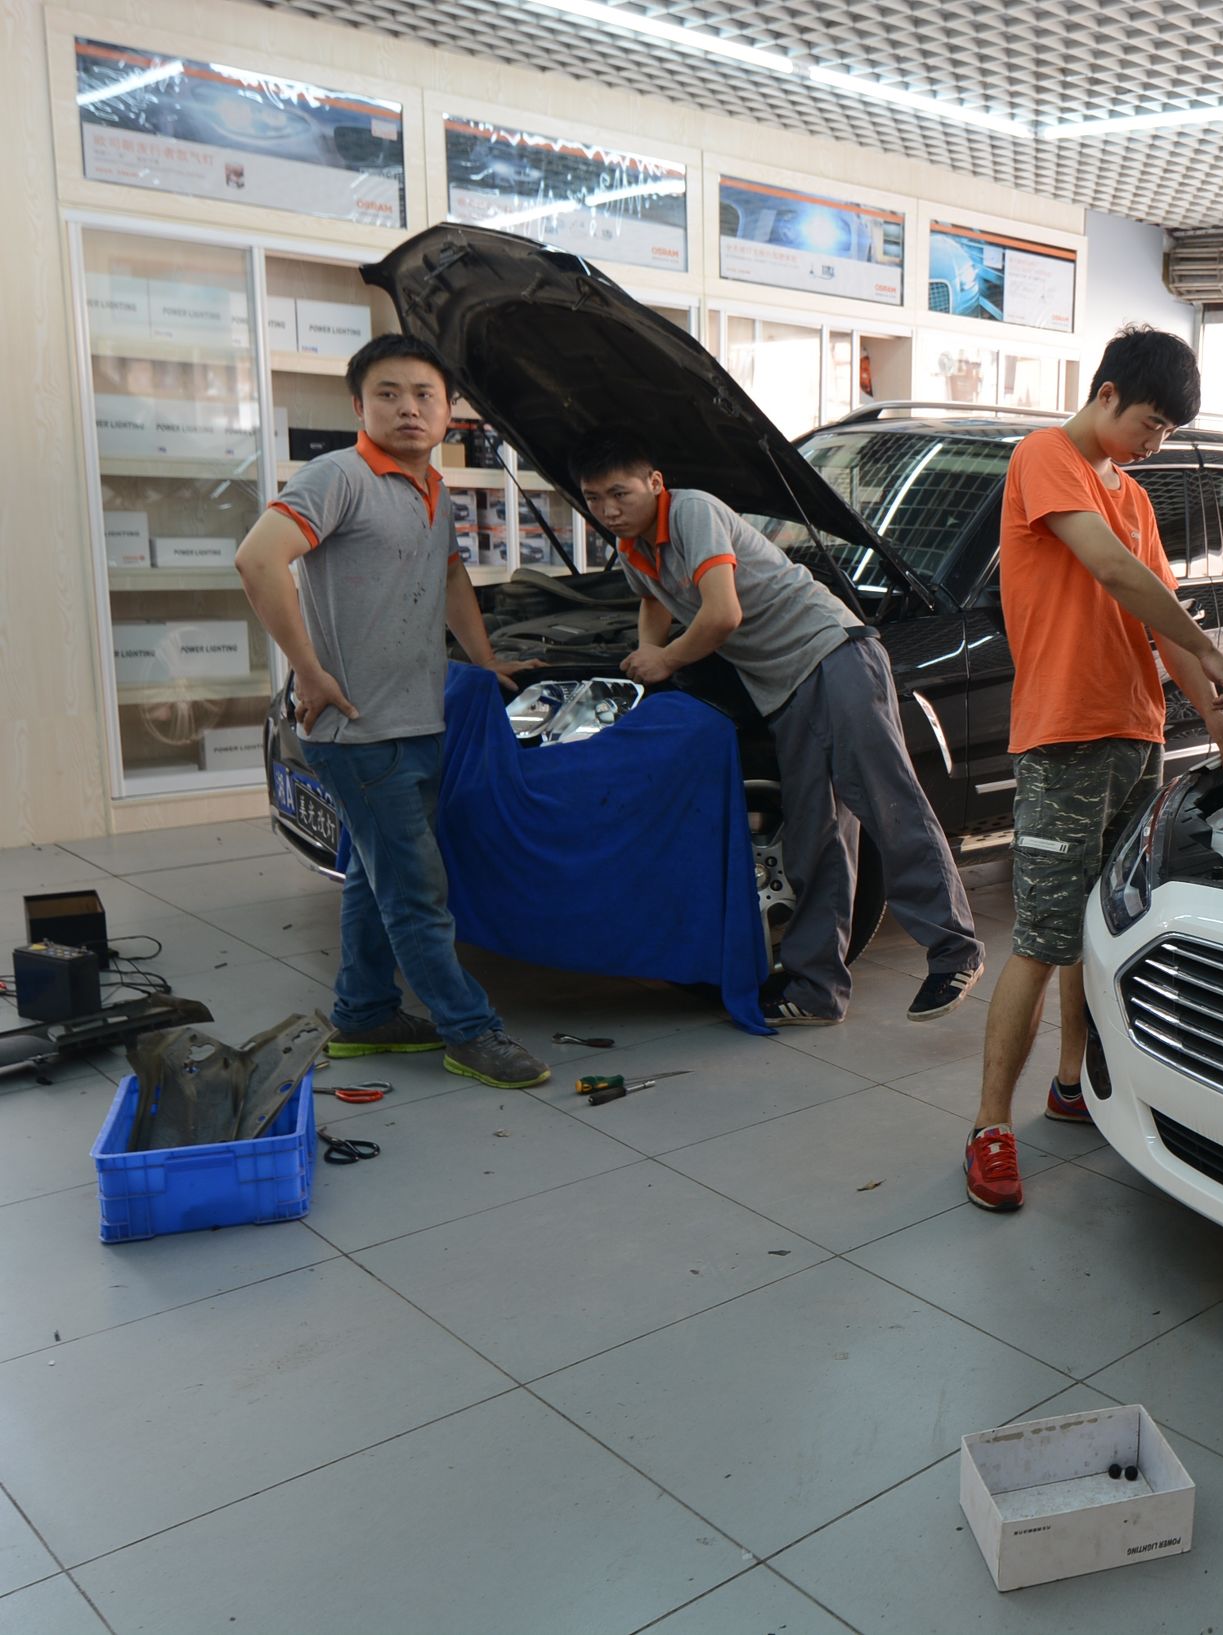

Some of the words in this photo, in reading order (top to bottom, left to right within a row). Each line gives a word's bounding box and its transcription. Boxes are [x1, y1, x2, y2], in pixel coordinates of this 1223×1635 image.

[356, 199, 393, 214] OSRAM
[100, 300, 137, 312] LIGHTING
[162, 306, 187, 318] POWER
[188, 309, 221, 321] LIGHTING
[309, 323, 331, 334] POWER
[332, 327, 362, 337] LIGHTING
[110, 419, 145, 431] LIGHTING
[156, 423, 180, 433] POWER
[173, 548, 194, 556] POWER
[121, 649, 156, 658] LIGHTING
[181, 645, 204, 654] POWER
[205, 643, 238, 653] LIGHTING
[213, 745, 238, 753] POWER
[1158, 1536, 1182, 1549] POWER
[1126, 1542, 1158, 1556] LIGHTING
